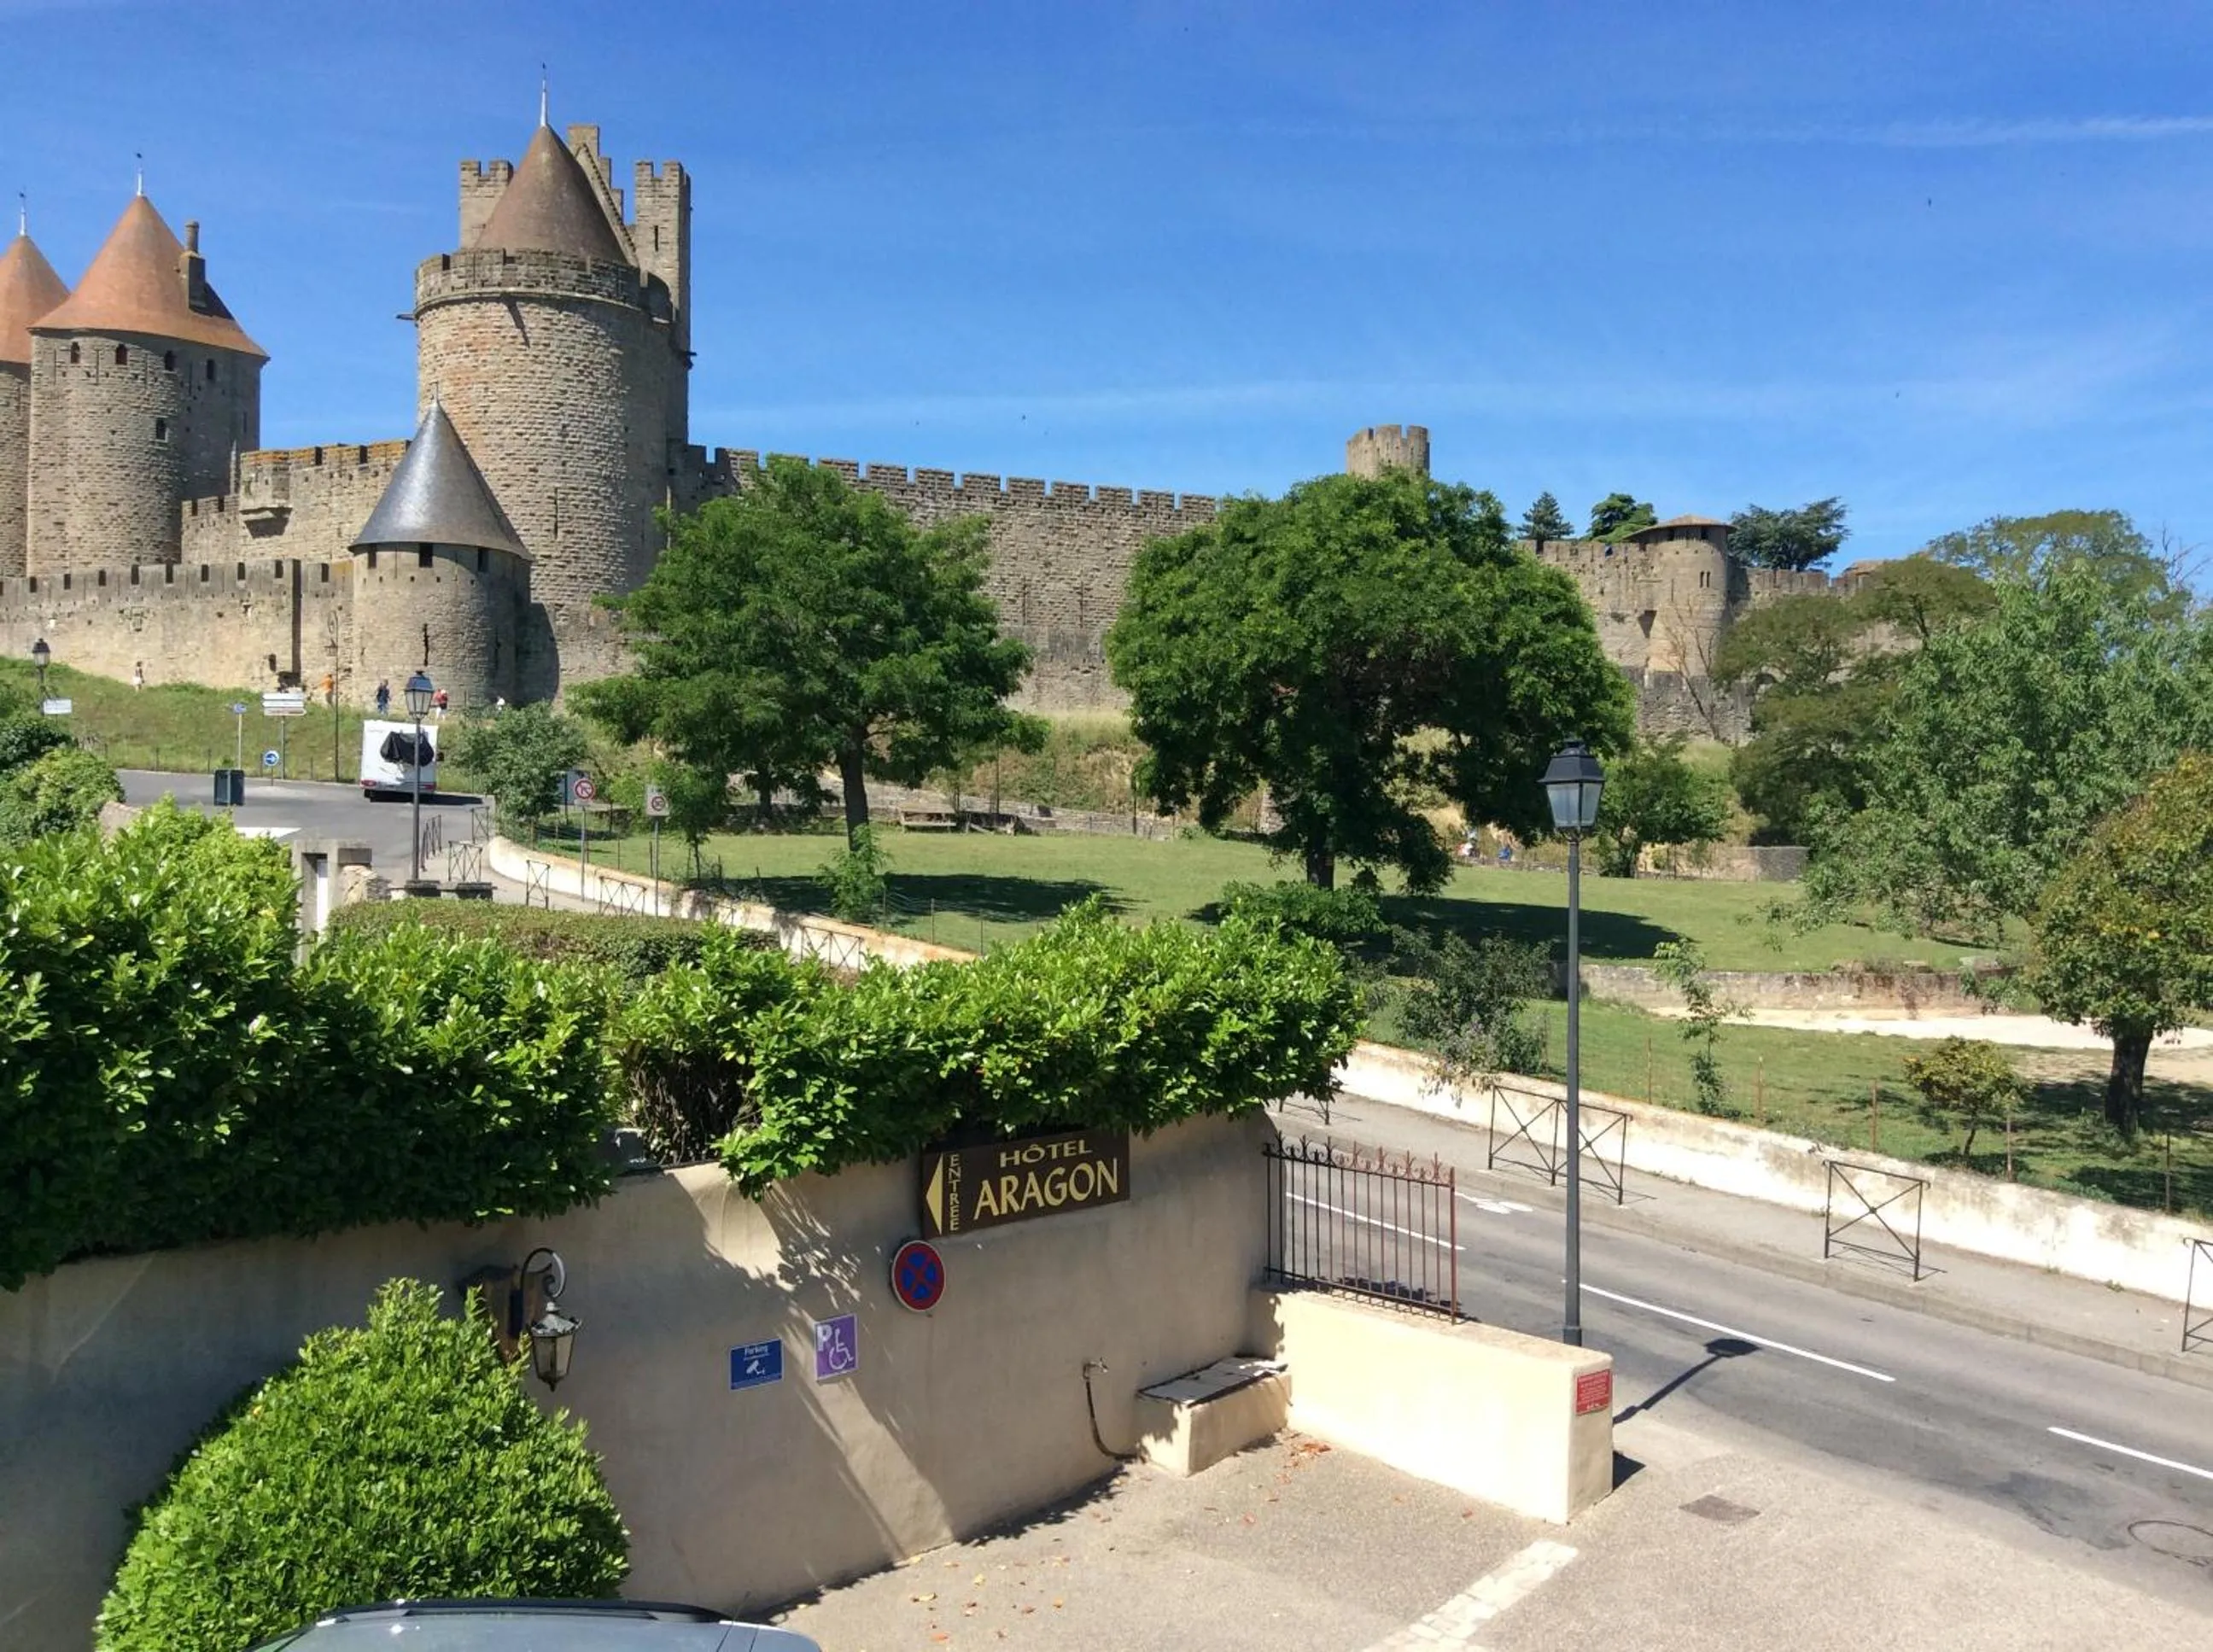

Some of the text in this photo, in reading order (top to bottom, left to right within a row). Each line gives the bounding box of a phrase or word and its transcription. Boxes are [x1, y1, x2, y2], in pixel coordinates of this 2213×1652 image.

[1000, 1140, 1092, 1168] HÔTEL
[973, 1158, 1118, 1221] ARAGON
[817, 1325, 832, 1351] P
